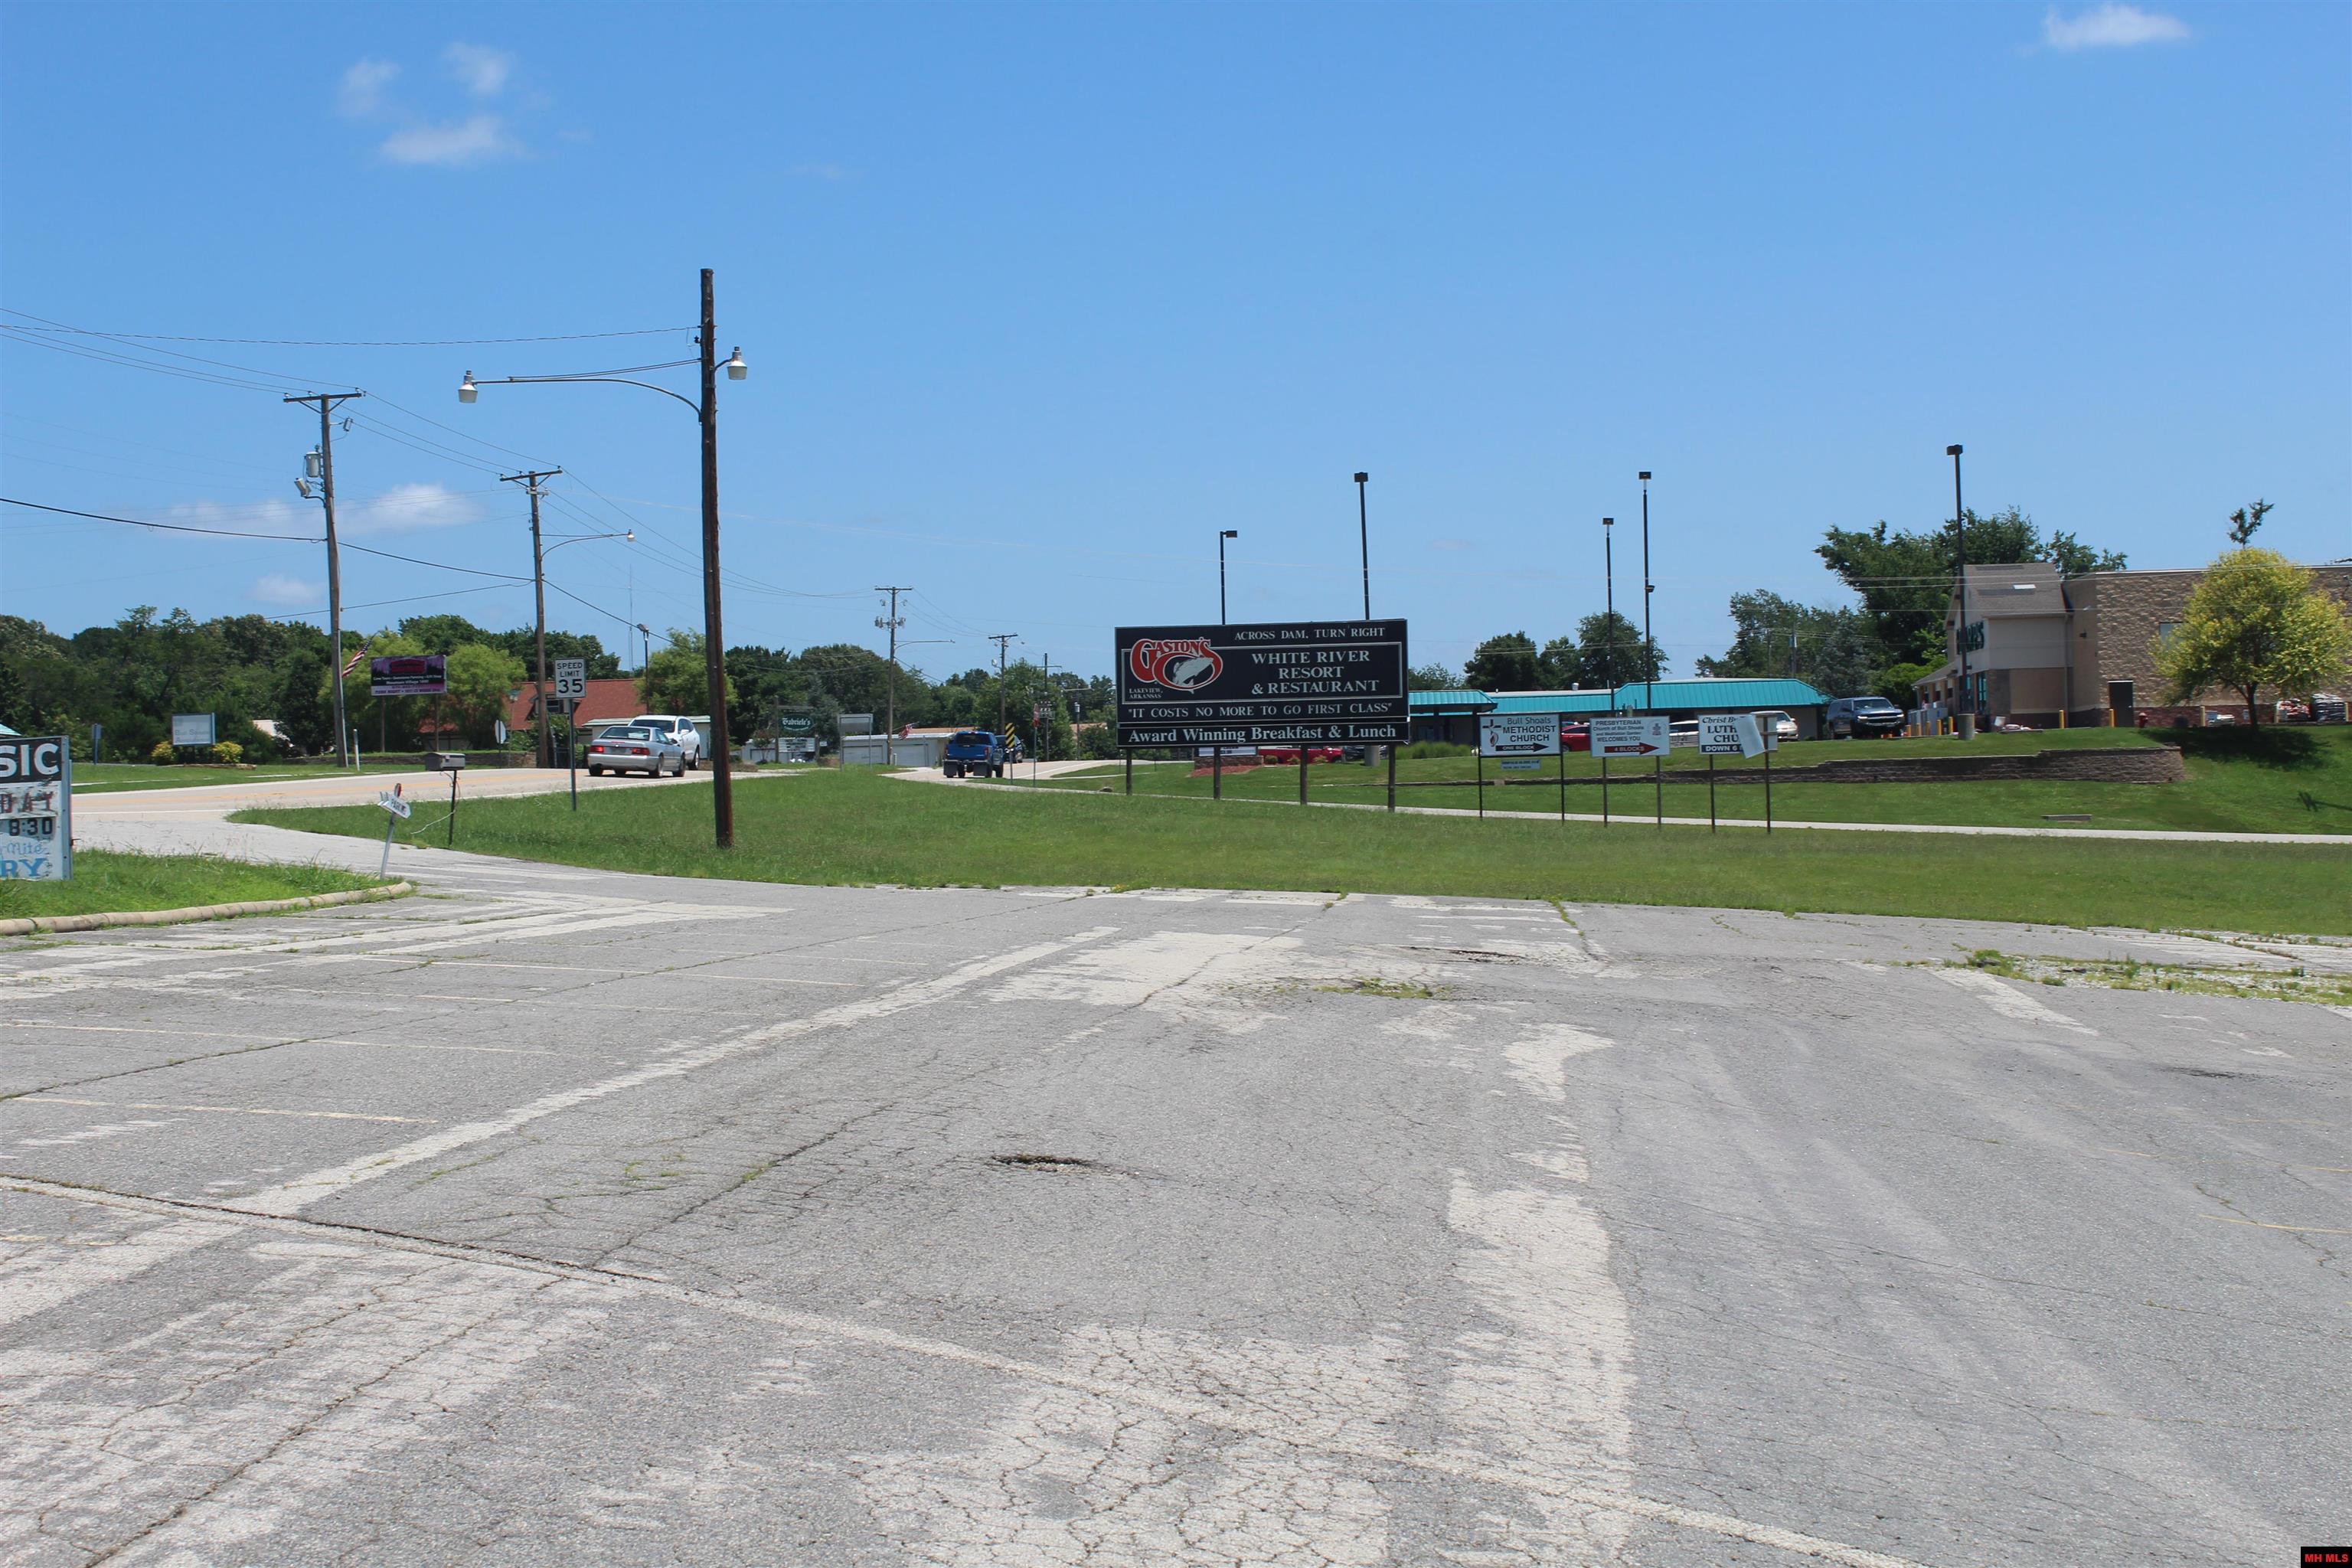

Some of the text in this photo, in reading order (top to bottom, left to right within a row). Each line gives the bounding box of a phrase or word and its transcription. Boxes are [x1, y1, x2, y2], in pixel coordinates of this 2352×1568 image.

[1234, 631, 1276, 640] ACROSS
[1314, 629, 1346, 638] TURN
[1351, 627, 1385, 637] RIGHT
[1252, 650, 1370, 665] WHITE RIVER
[557, 662, 583, 670] SPEED
[1279, 666, 1344, 679] RESORT
[558, 678, 583, 694] 35
[1252, 680, 1380, 694] & RESTAURANT
[1151, 707, 1189, 718] COSTS
[1195, 707, 1213, 717] NO
[1220, 706, 1254, 716] MORE
[1260, 705, 1277, 715] TO
[1283, 705, 1301, 714] GO
[1308, 704, 1343, 714] FIRST
[1129, 724, 1396, 743] Award Winning Breakfast & Lunch
[1502, 725, 1557, 733] METHODIST
[9, 817, 53, 836] 8:30
